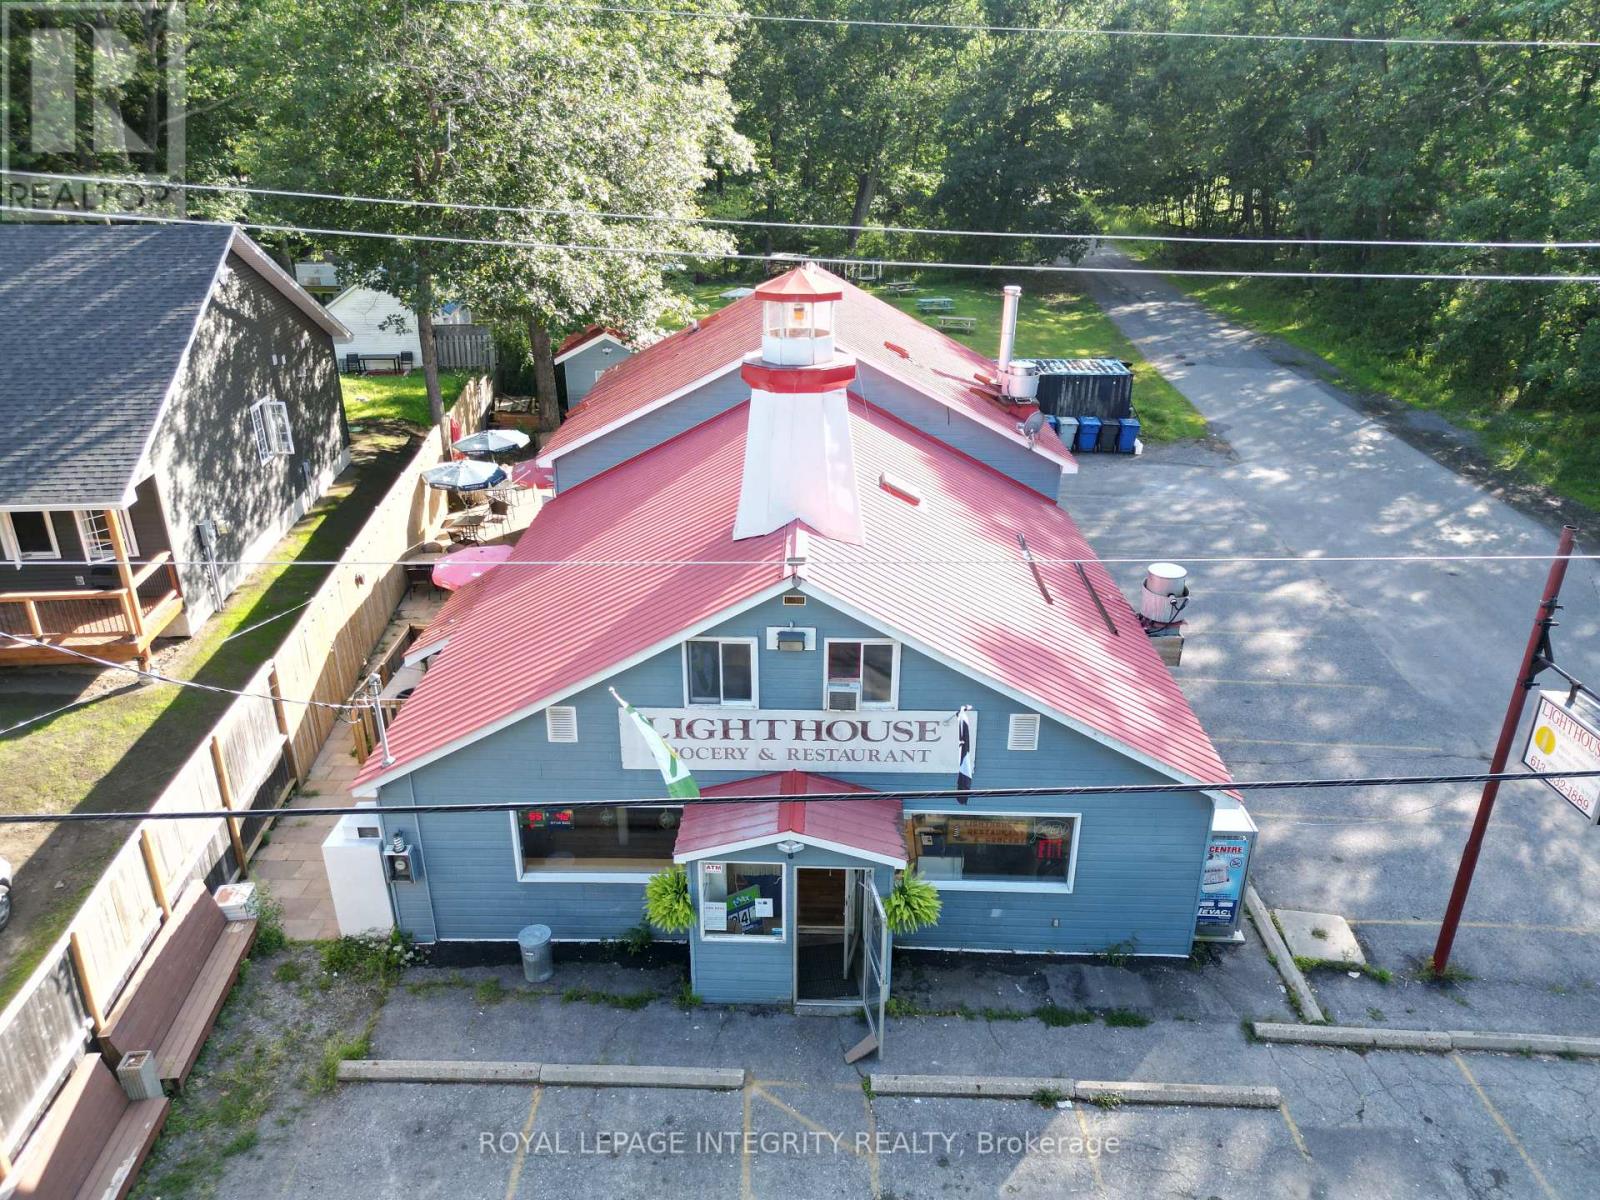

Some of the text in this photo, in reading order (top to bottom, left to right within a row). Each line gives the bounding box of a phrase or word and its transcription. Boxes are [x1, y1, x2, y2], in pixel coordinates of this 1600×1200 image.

[653, 746, 932, 764] OCERY & RESTAURANT
